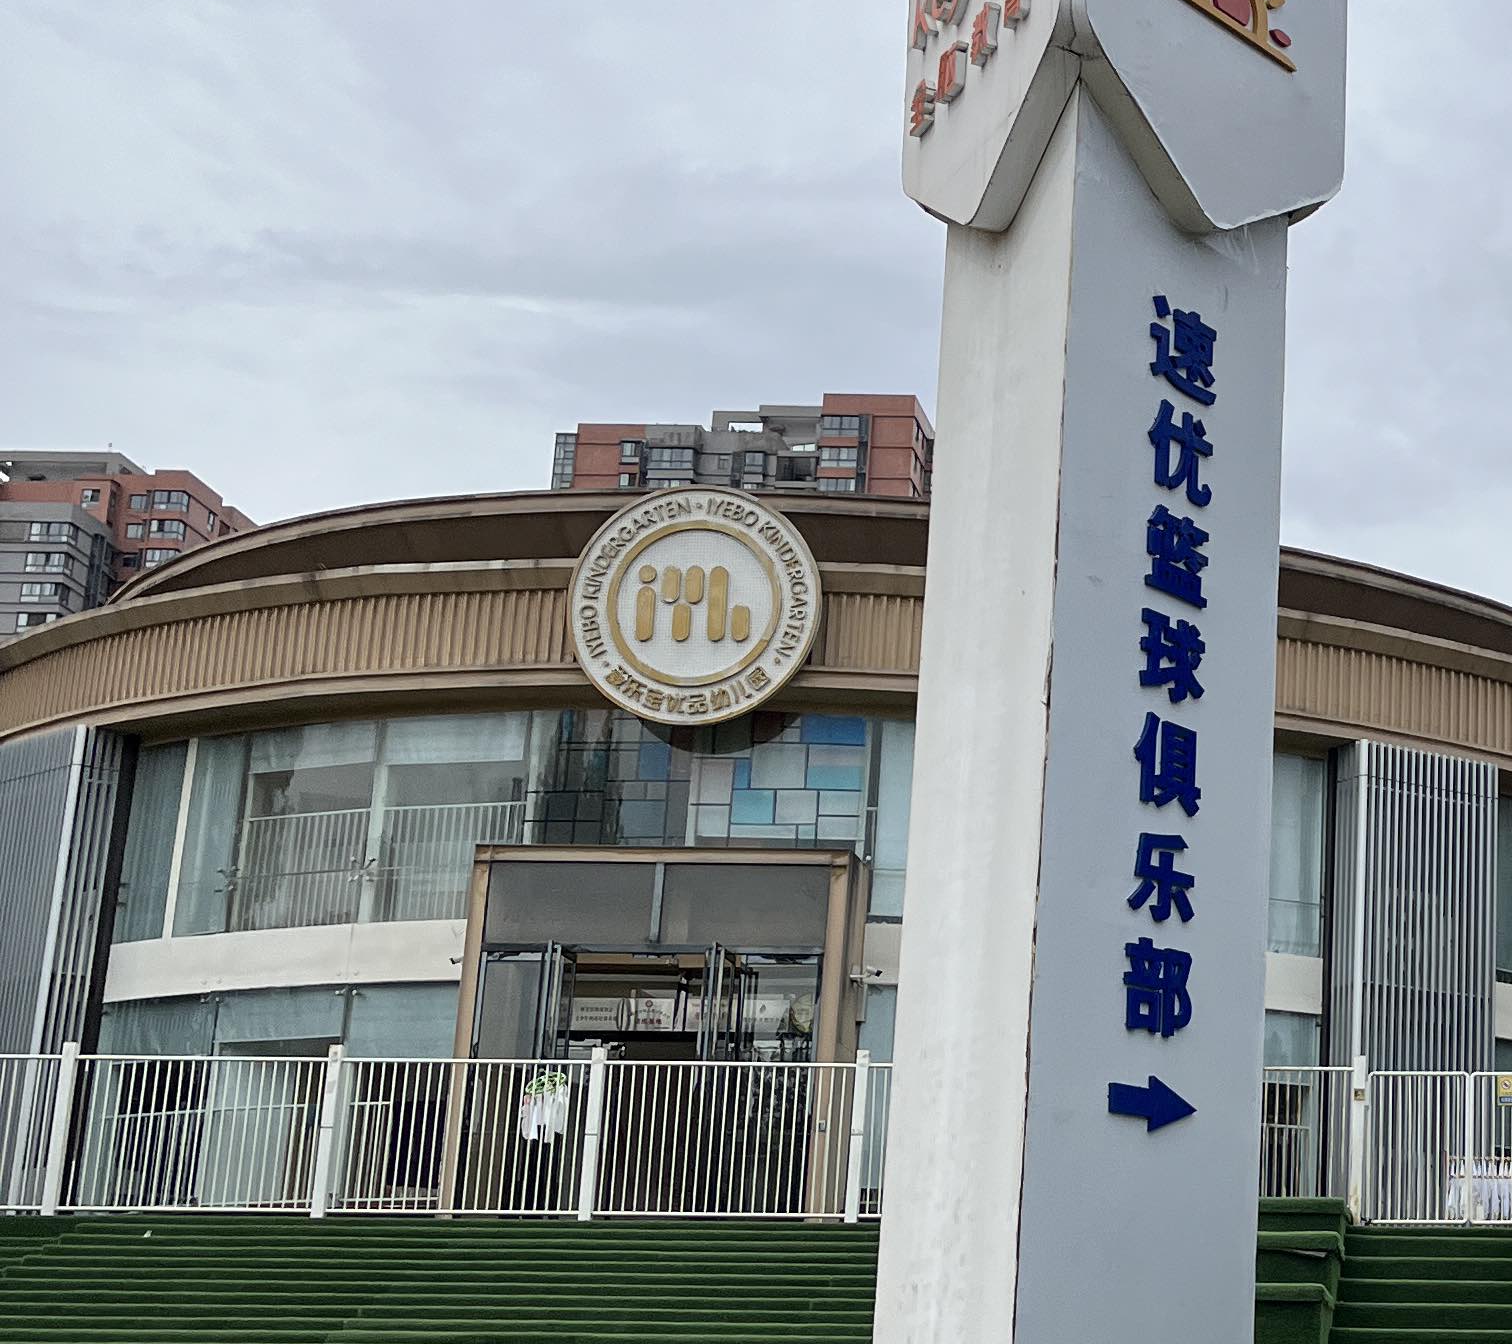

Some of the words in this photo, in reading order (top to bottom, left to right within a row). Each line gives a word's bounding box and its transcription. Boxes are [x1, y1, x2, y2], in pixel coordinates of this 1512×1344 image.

[582, 497, 692, 600] KINDERGARTEN
[758, 520, 809, 658] KINDERGARTEN
[1123, 296, 1217, 1038] 速优篮球俱乐部
